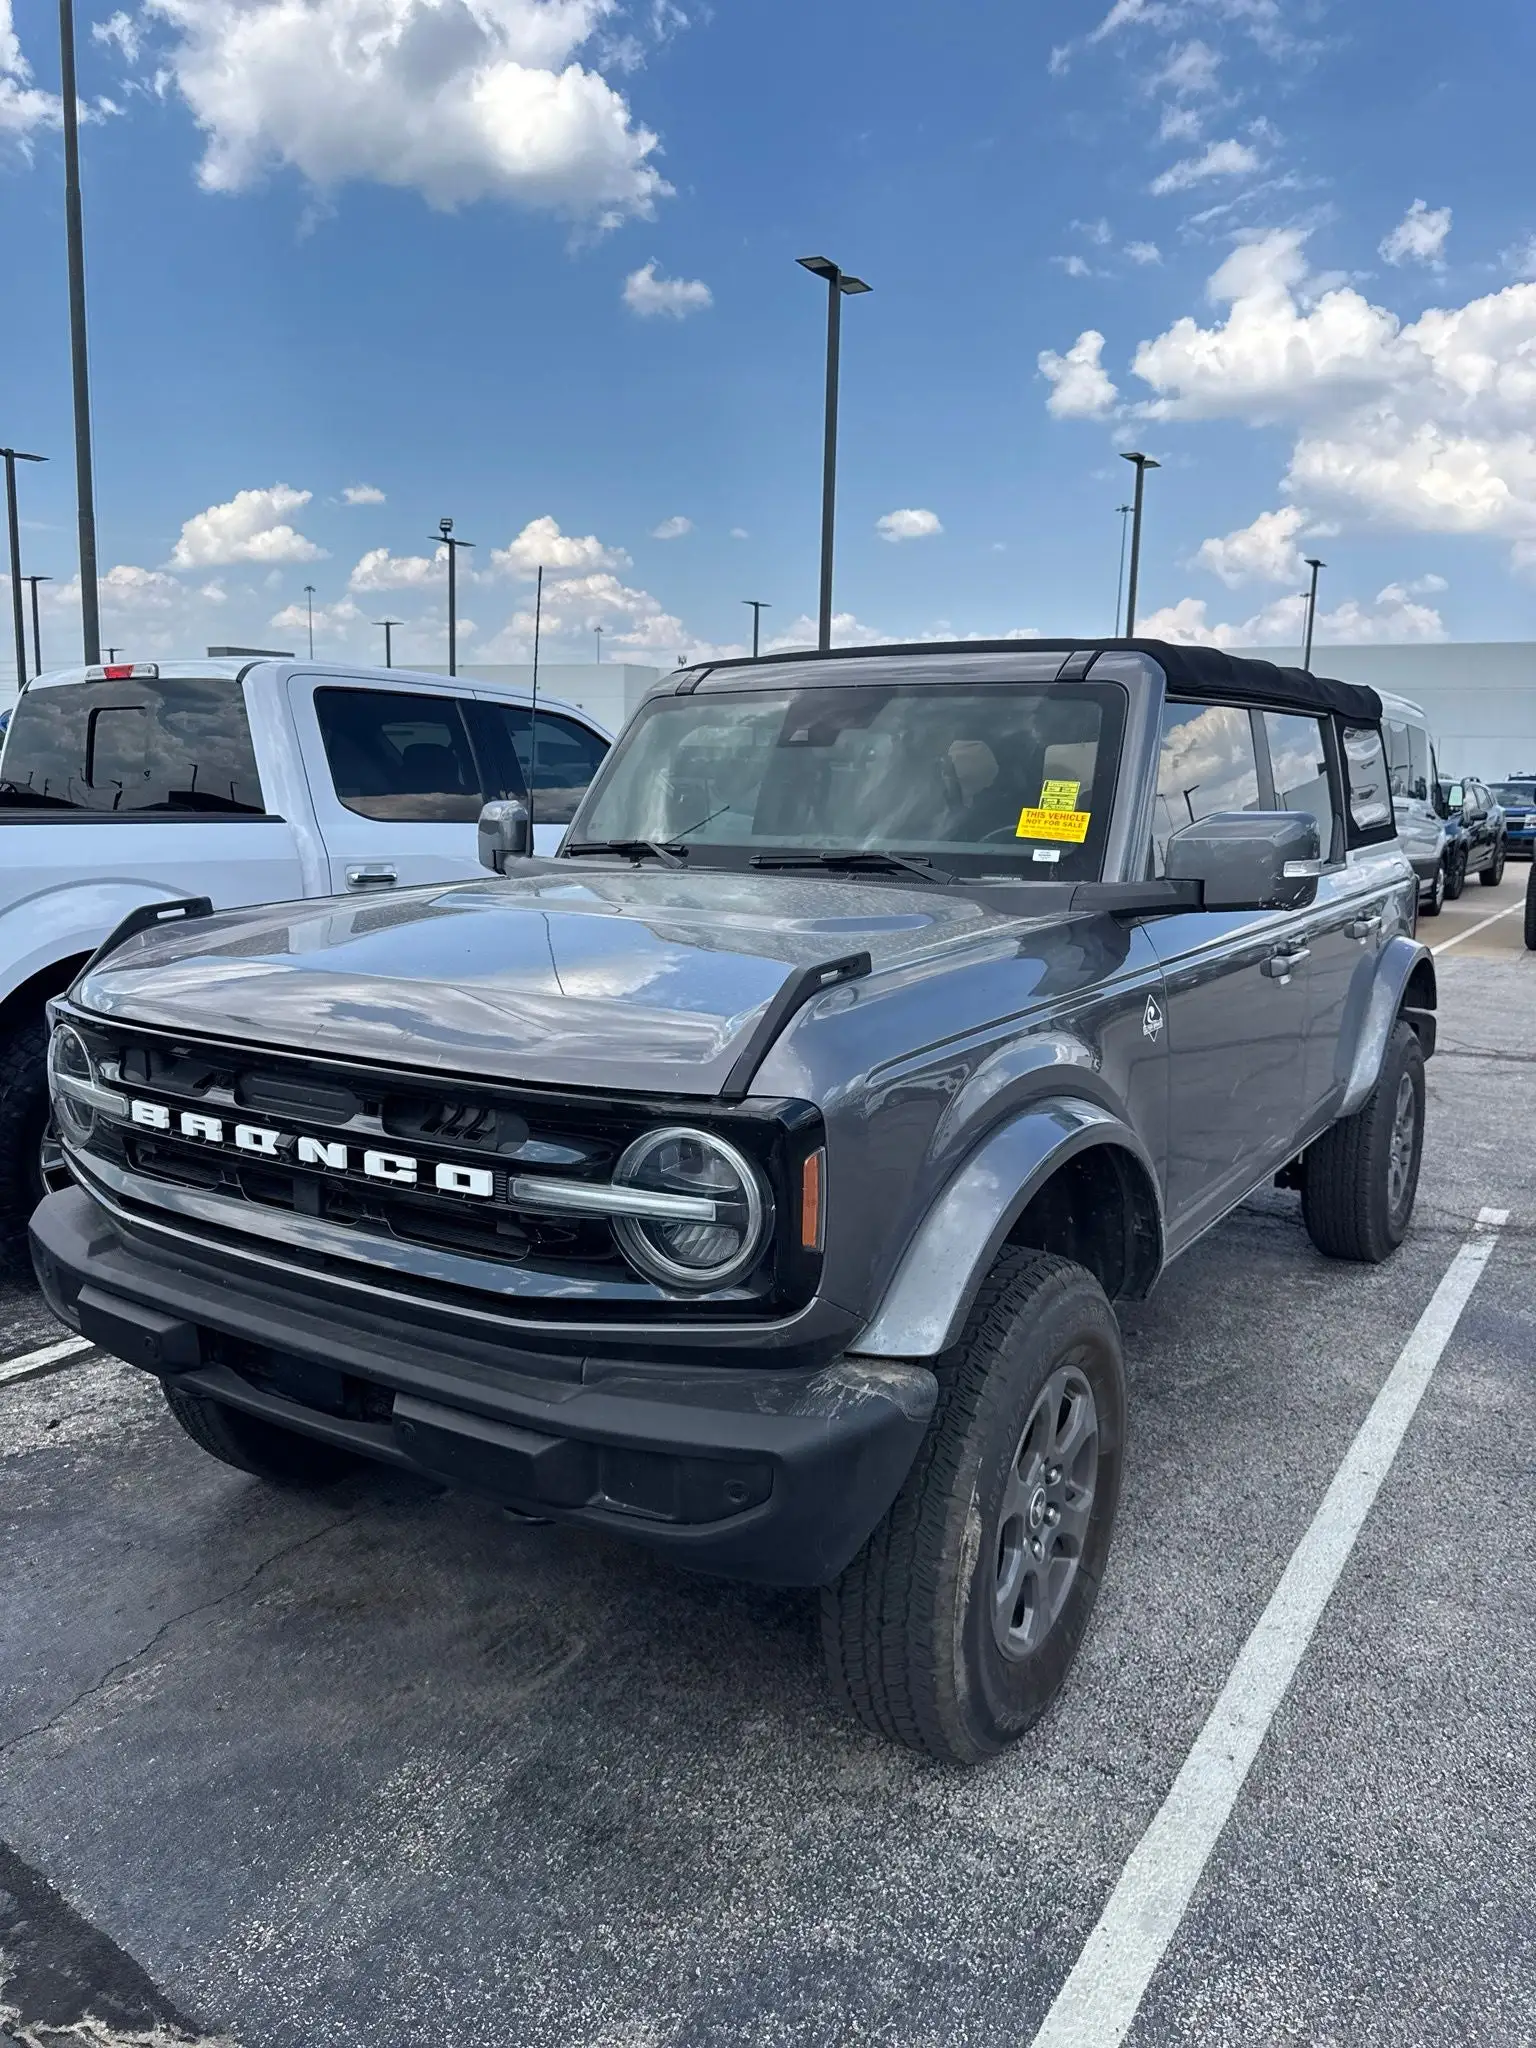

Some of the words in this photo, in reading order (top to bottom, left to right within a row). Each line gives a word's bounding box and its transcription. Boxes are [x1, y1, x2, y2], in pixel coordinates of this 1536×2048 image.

[1026, 811, 1046, 819] THIS
[1049, 812, 1088, 822] VEHICLE
[131, 1099, 494, 1197] BRONCO
